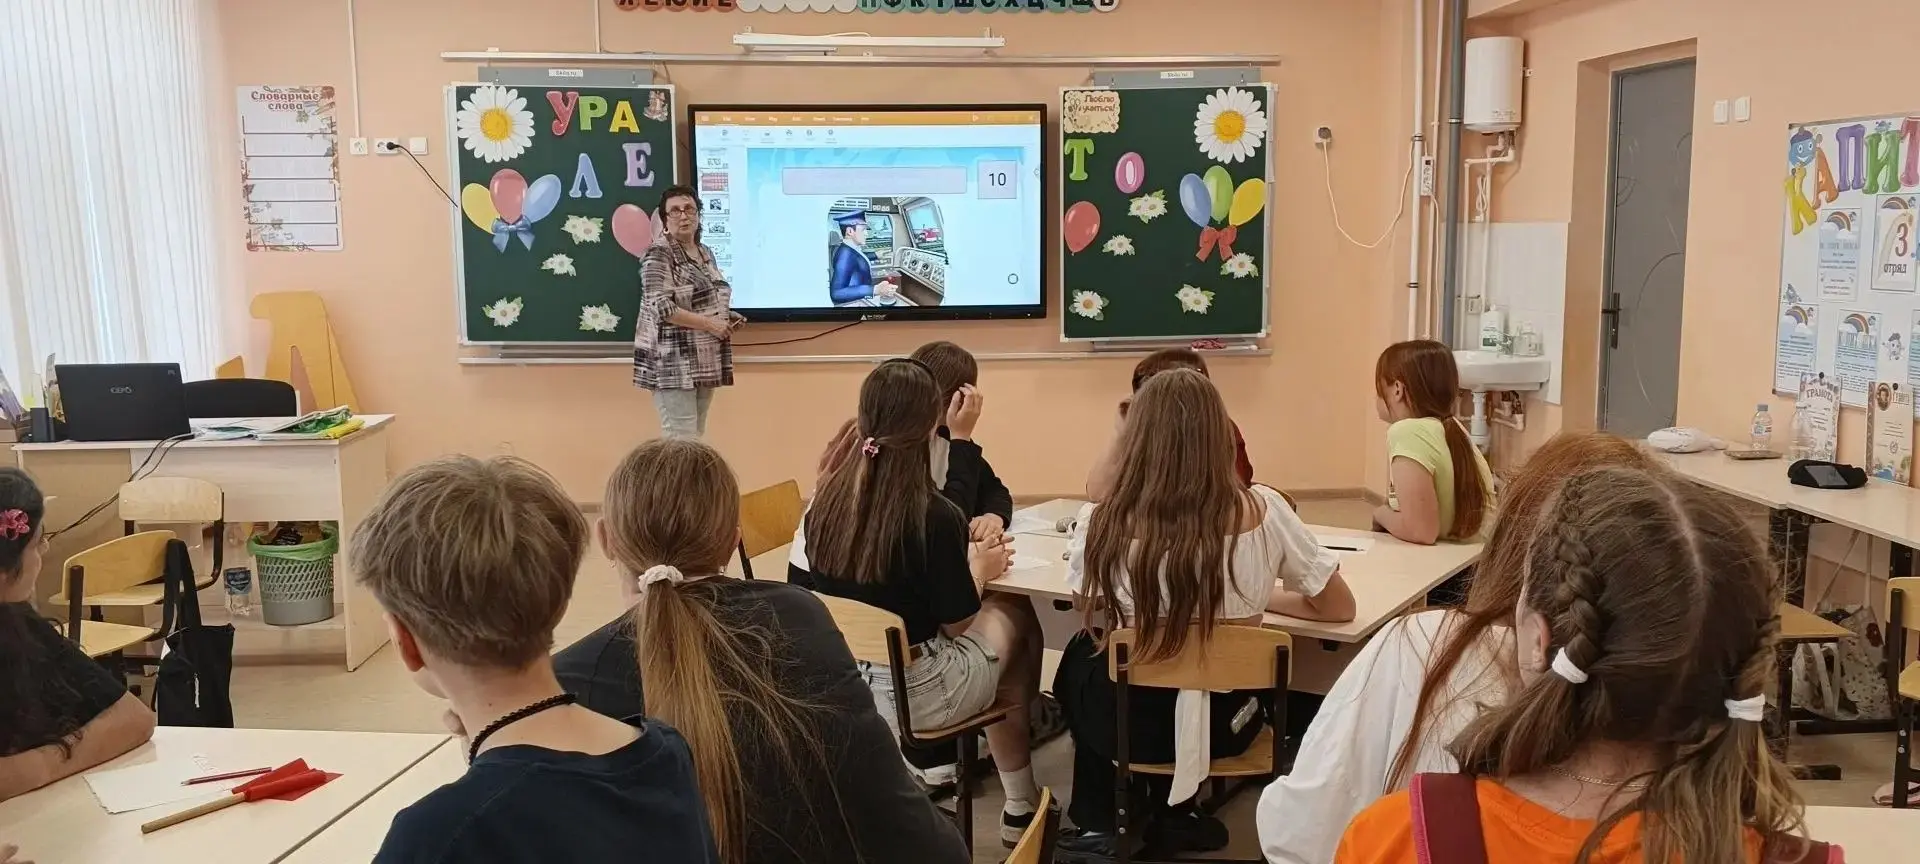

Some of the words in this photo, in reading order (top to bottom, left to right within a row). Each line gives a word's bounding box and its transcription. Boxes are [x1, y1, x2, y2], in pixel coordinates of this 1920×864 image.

[251, 91, 320, 101] Словарные
[1084, 94, 1115, 103] Люблю
[268, 102, 303, 110] слова
[1082, 104, 1116, 113] учиться!
[546, 91, 640, 135] УРА
[988, 172, 1007, 187] 10
[1883, 263, 1907, 276] отряд
